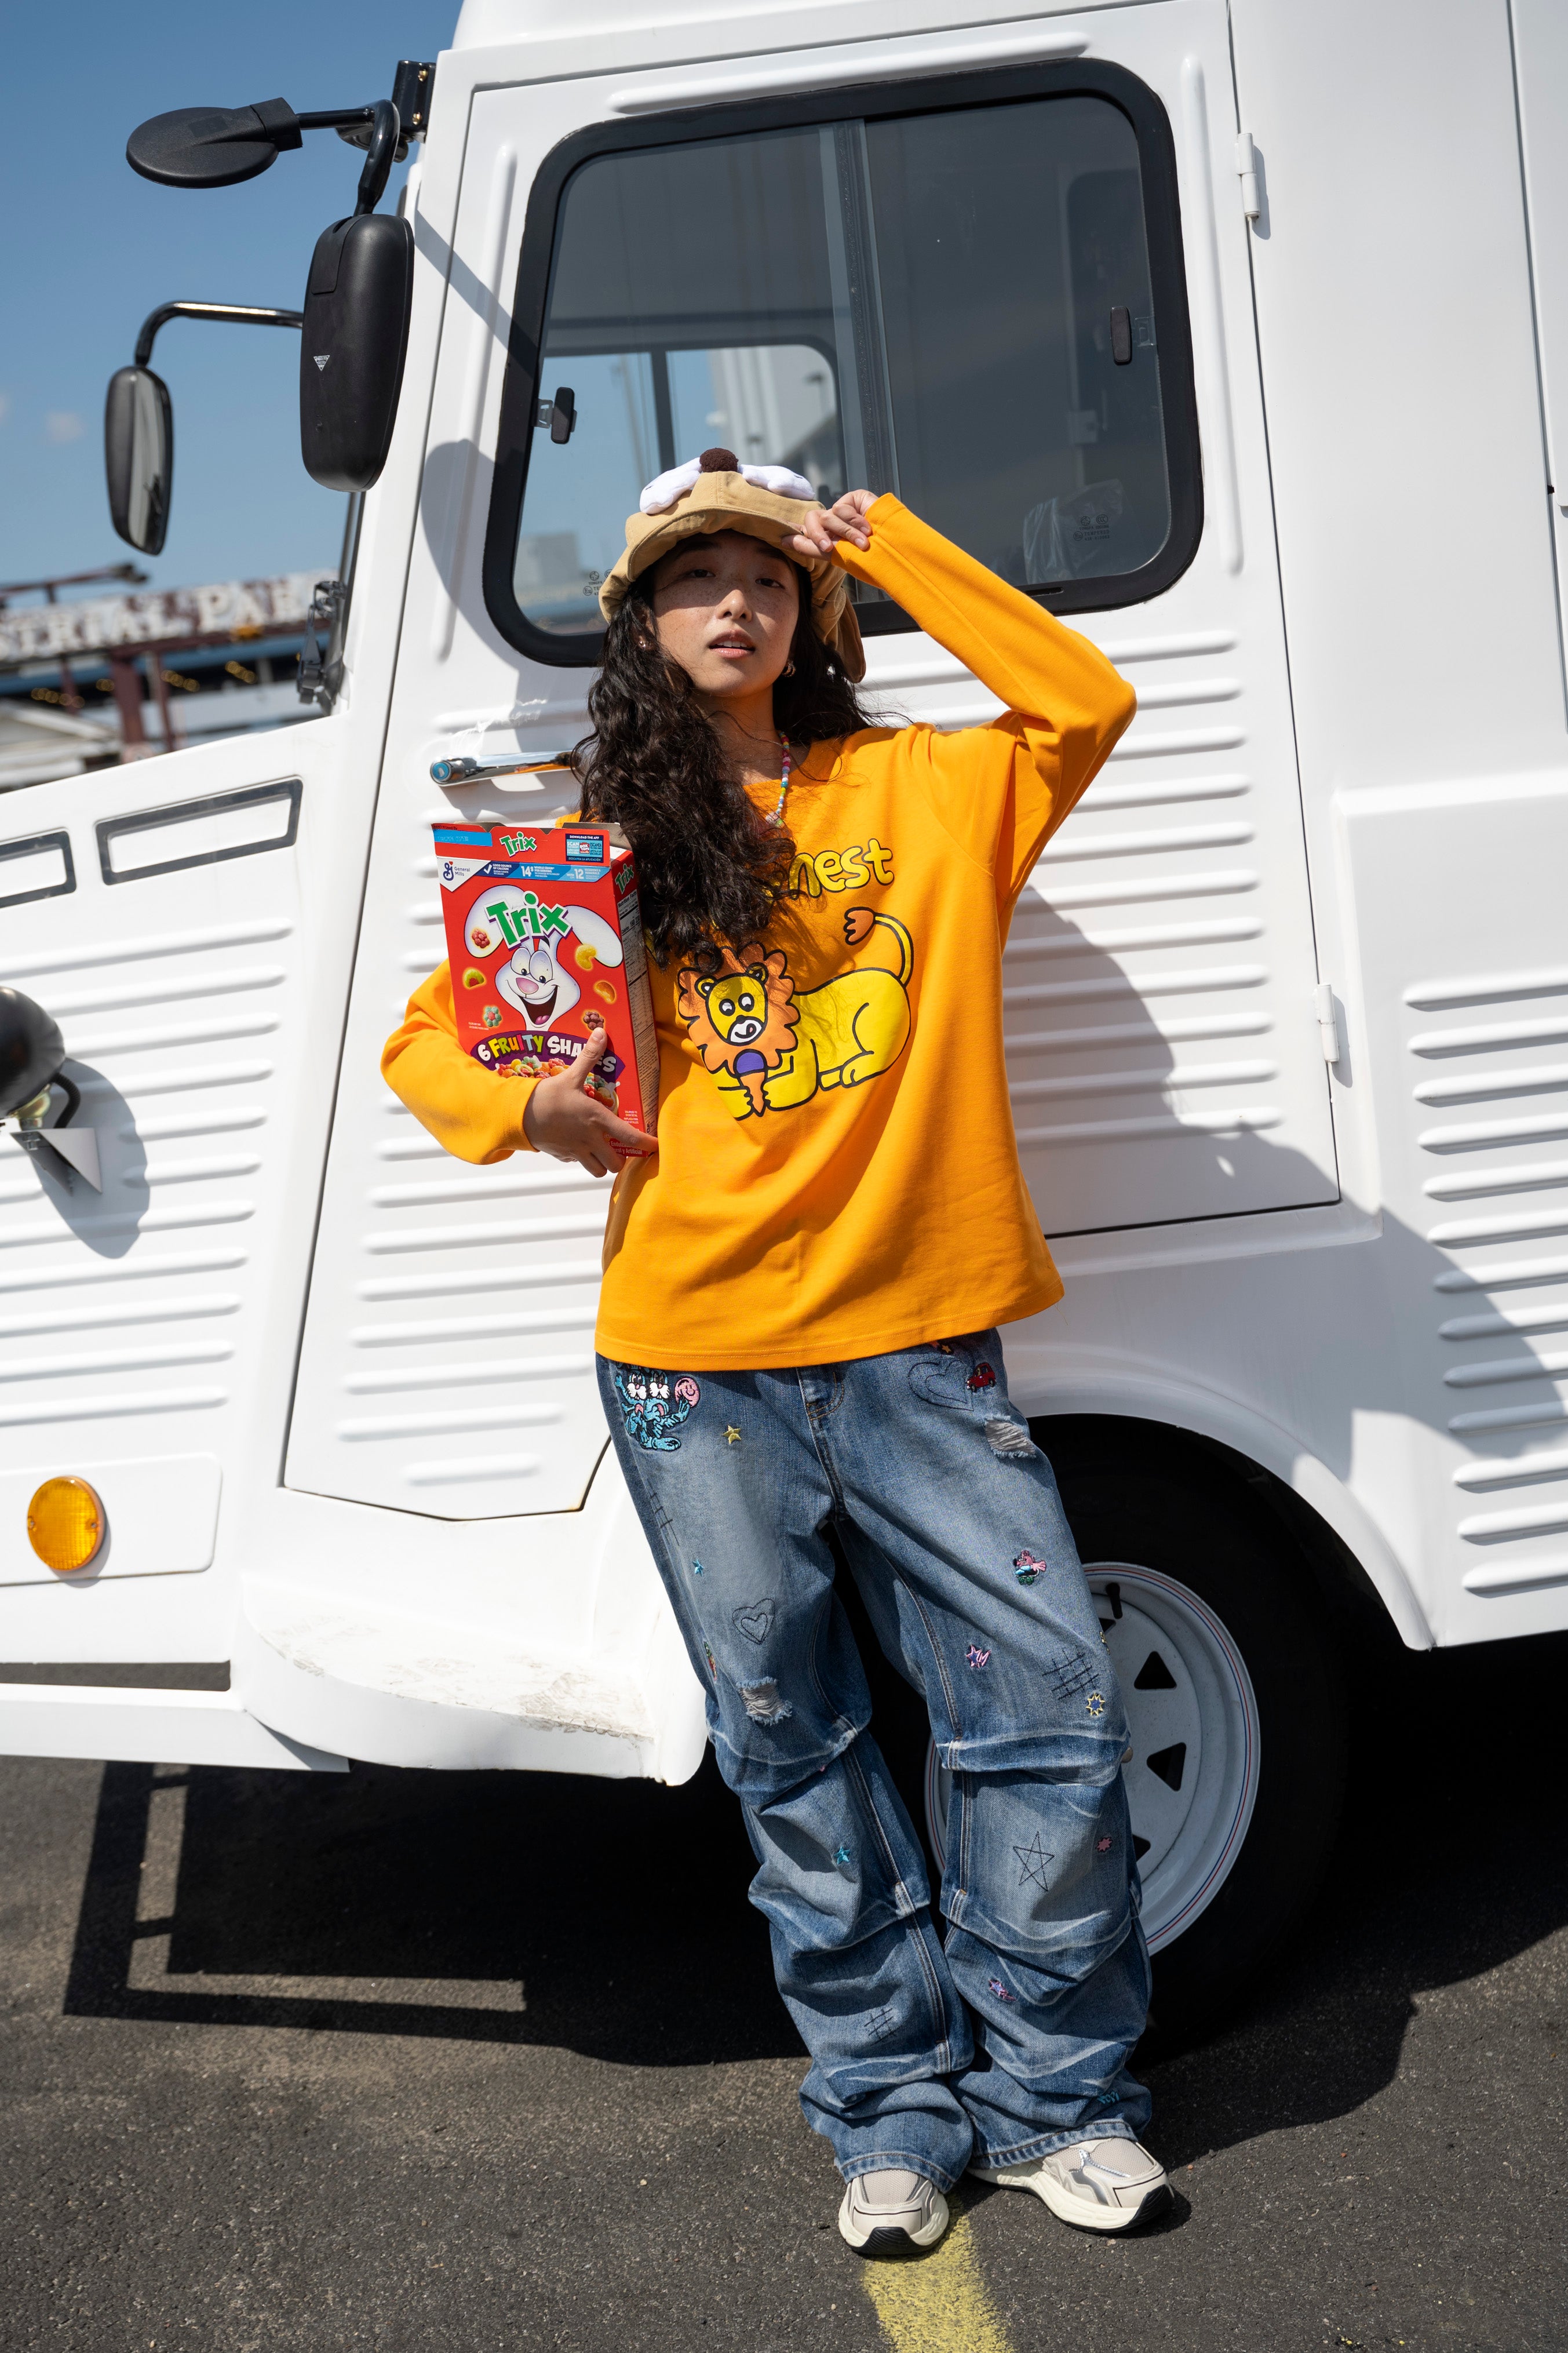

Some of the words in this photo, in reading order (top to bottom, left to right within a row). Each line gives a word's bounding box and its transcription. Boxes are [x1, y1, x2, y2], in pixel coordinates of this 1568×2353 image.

[499, 831, 537, 857] Trix
[574, 868, 584, 879] 12
[615, 863, 635, 894] Trix
[783, 838, 894, 900] nest
[484, 890, 572, 950] Trix
[477, 1044, 491, 1061] 6
[488, 1035, 544, 1058] FRUITY
[547, 1036, 617, 1072] SHAS
